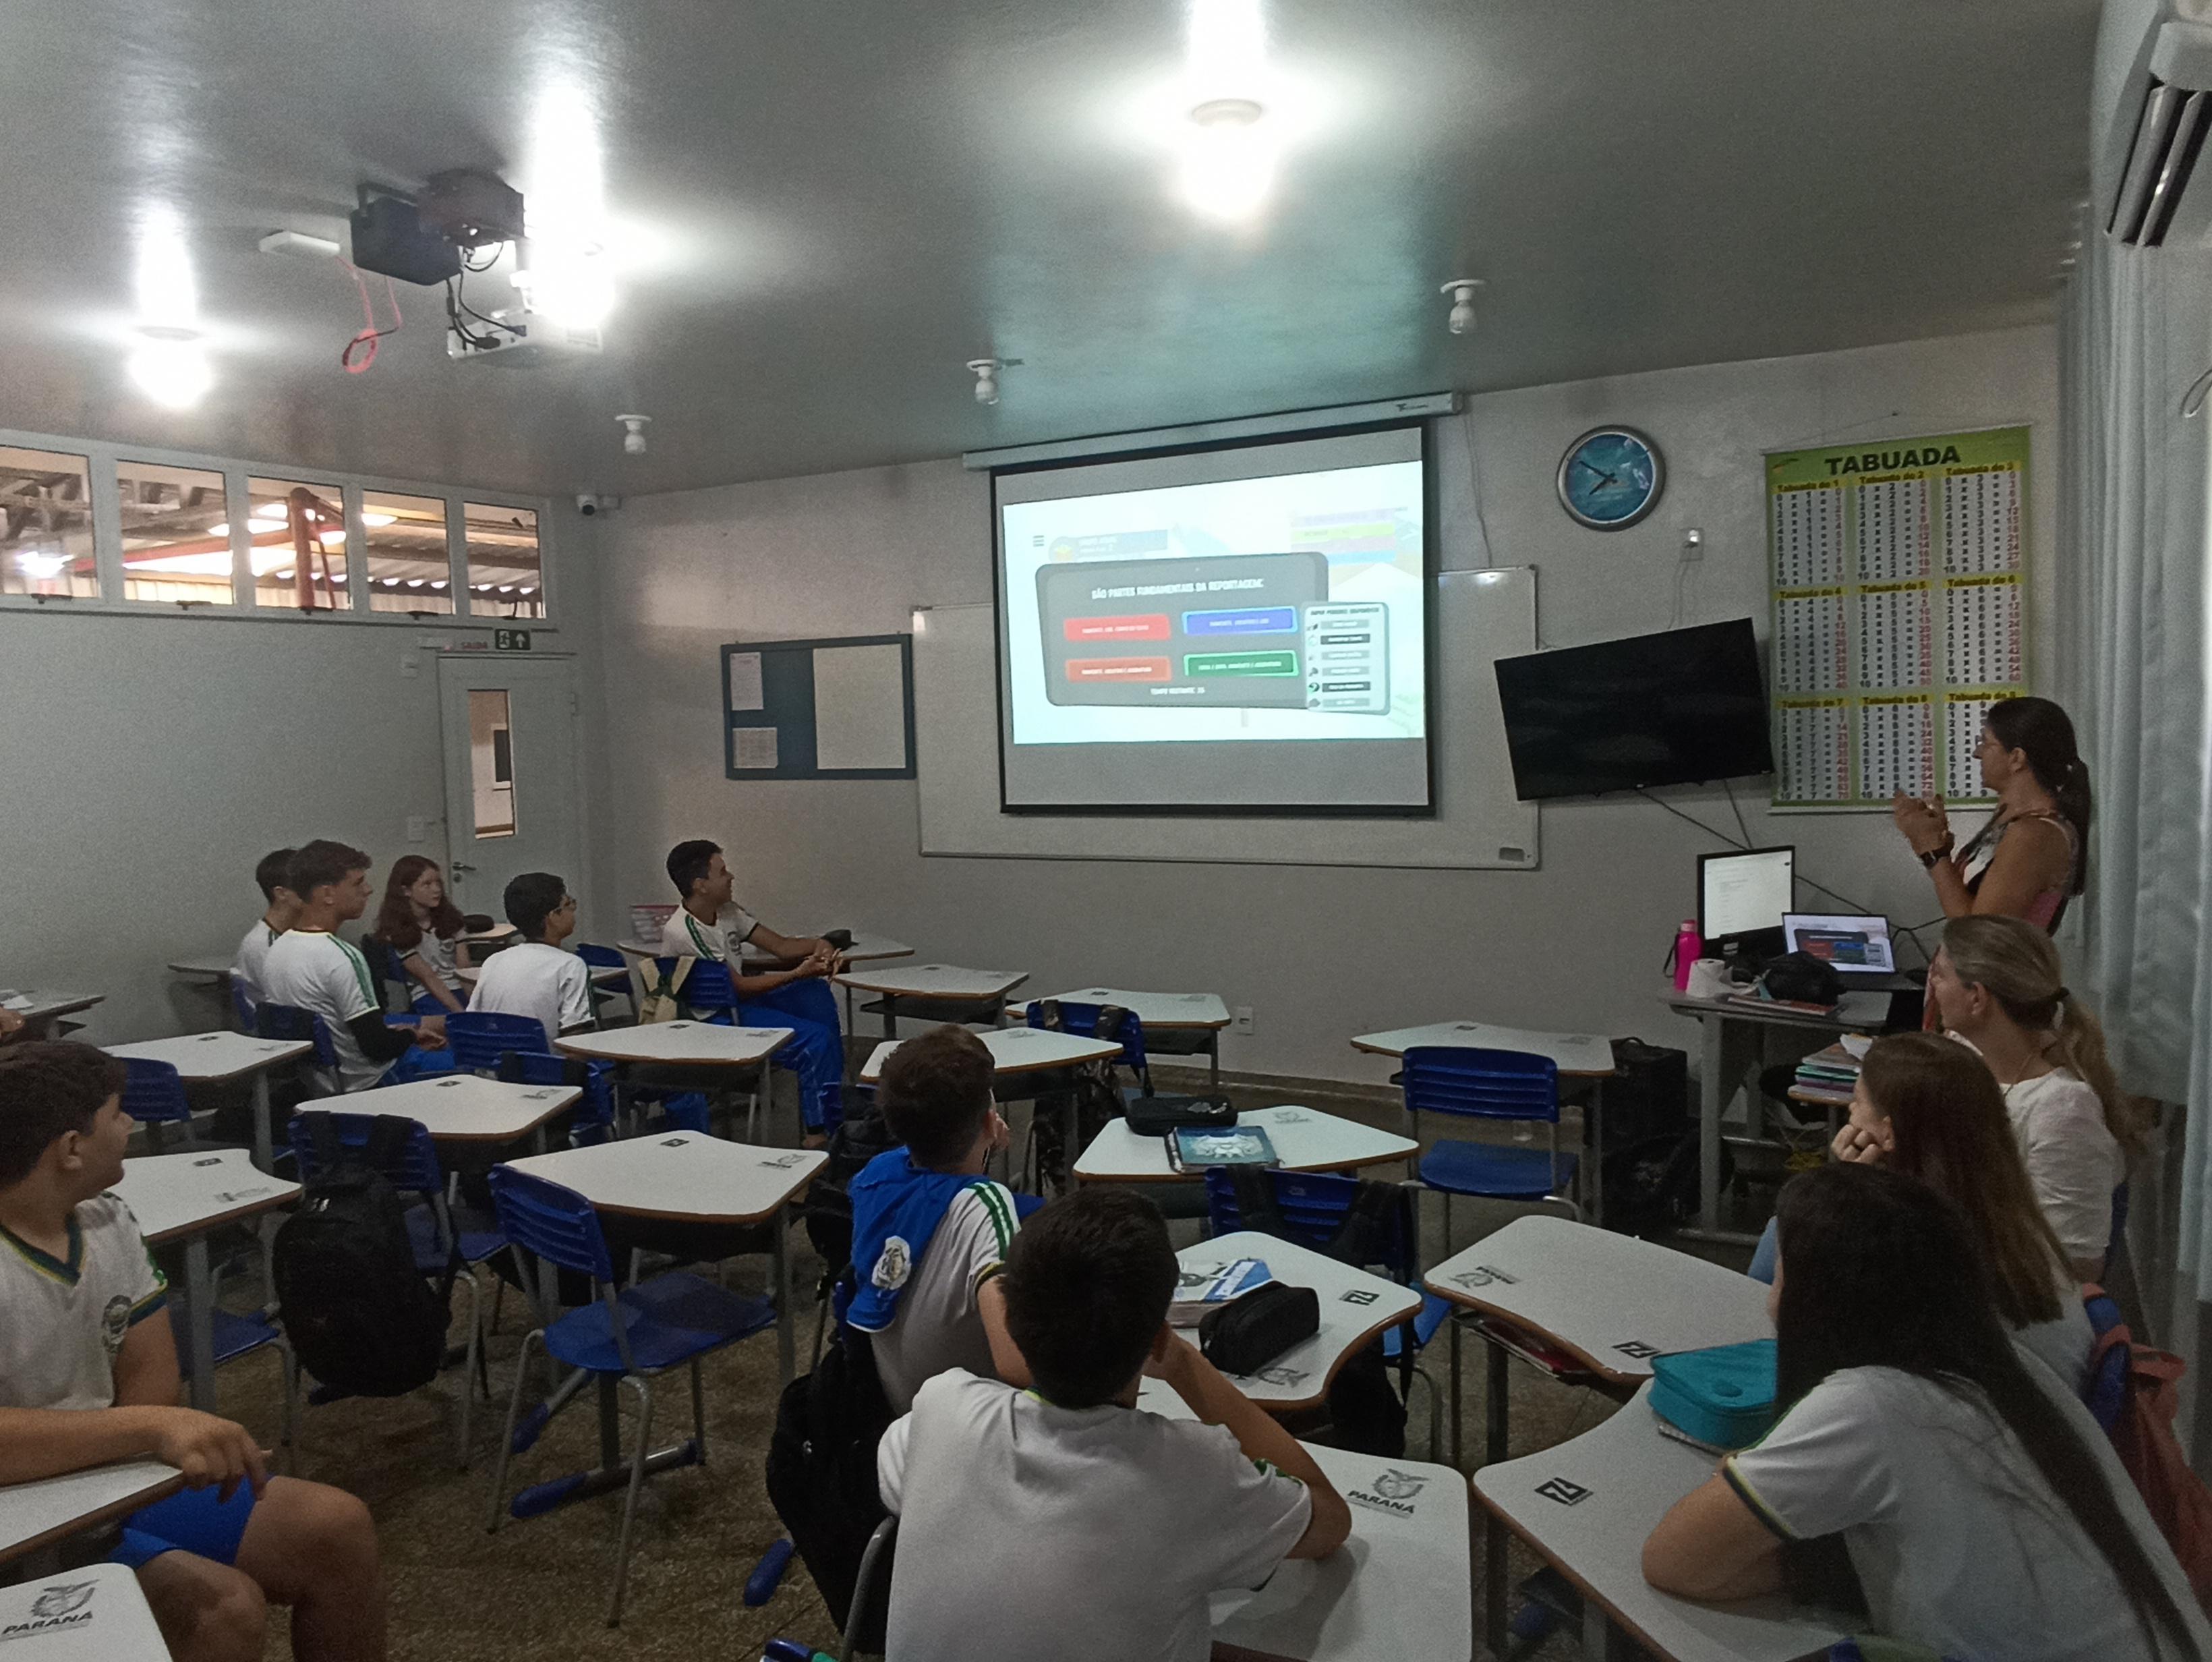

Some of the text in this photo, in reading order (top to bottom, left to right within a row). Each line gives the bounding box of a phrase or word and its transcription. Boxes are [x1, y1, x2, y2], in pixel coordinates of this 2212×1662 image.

[1824, 446, 1960, 475] TABUADA
[2007, 461, 2013, 470] 3
[1918, 471, 1924, 479] 2
[2008, 575, 2015, 583] 6
[1919, 581, 1926, 589] 5
[1835, 586, 1841, 594] 4
